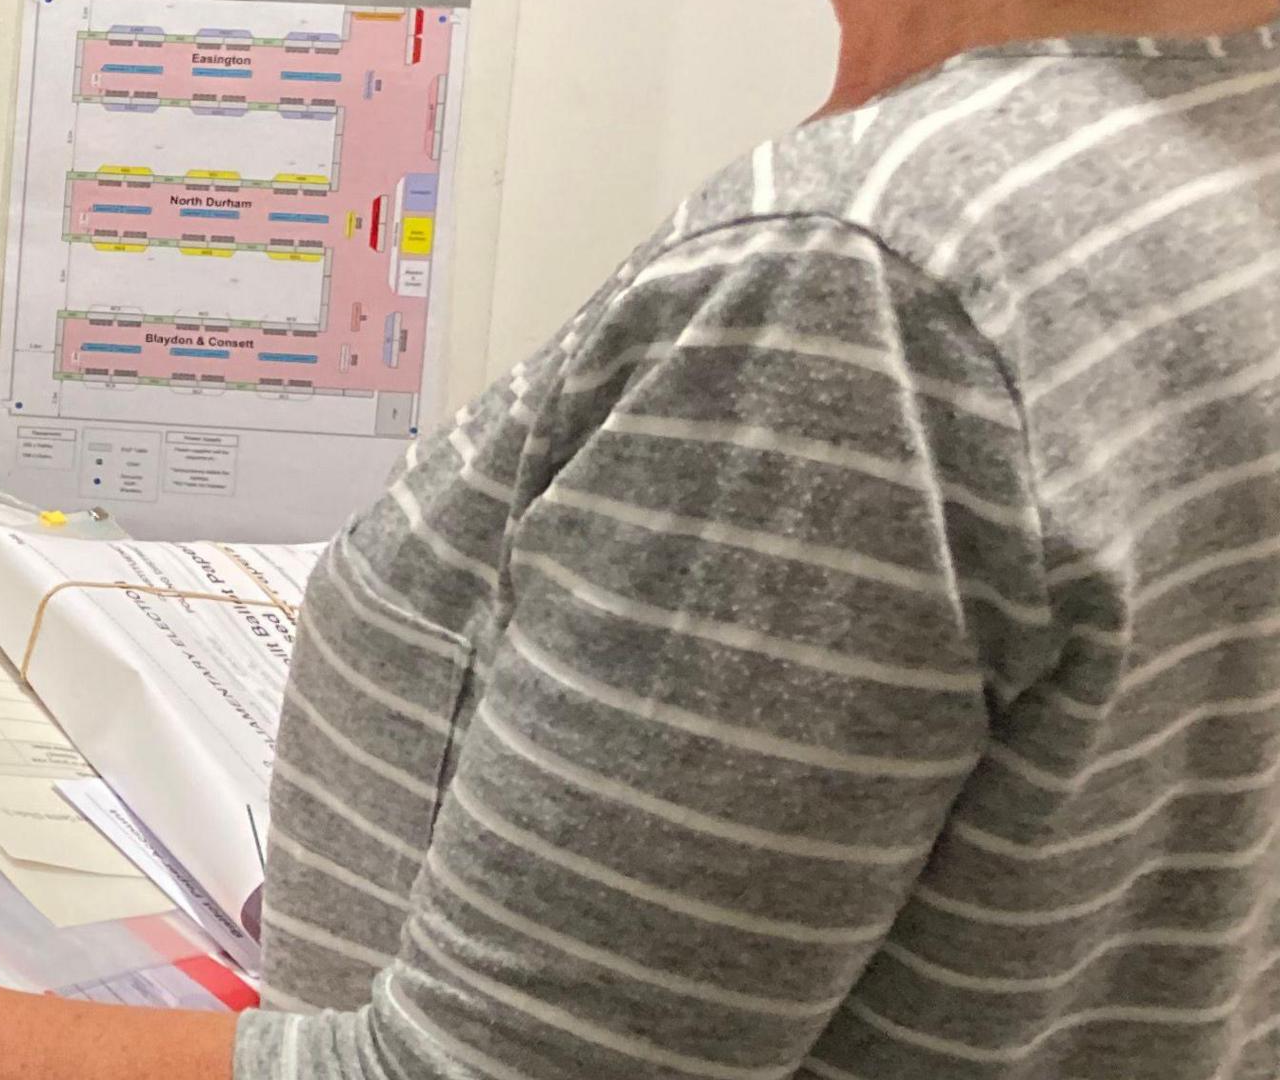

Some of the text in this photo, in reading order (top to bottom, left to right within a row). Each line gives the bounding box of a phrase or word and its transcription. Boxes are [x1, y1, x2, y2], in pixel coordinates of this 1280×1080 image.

[192, 54, 251, 66] Easington
[170, 196, 252, 208] North Durham
[144, 334, 254, 349] Blaydon & Consett
